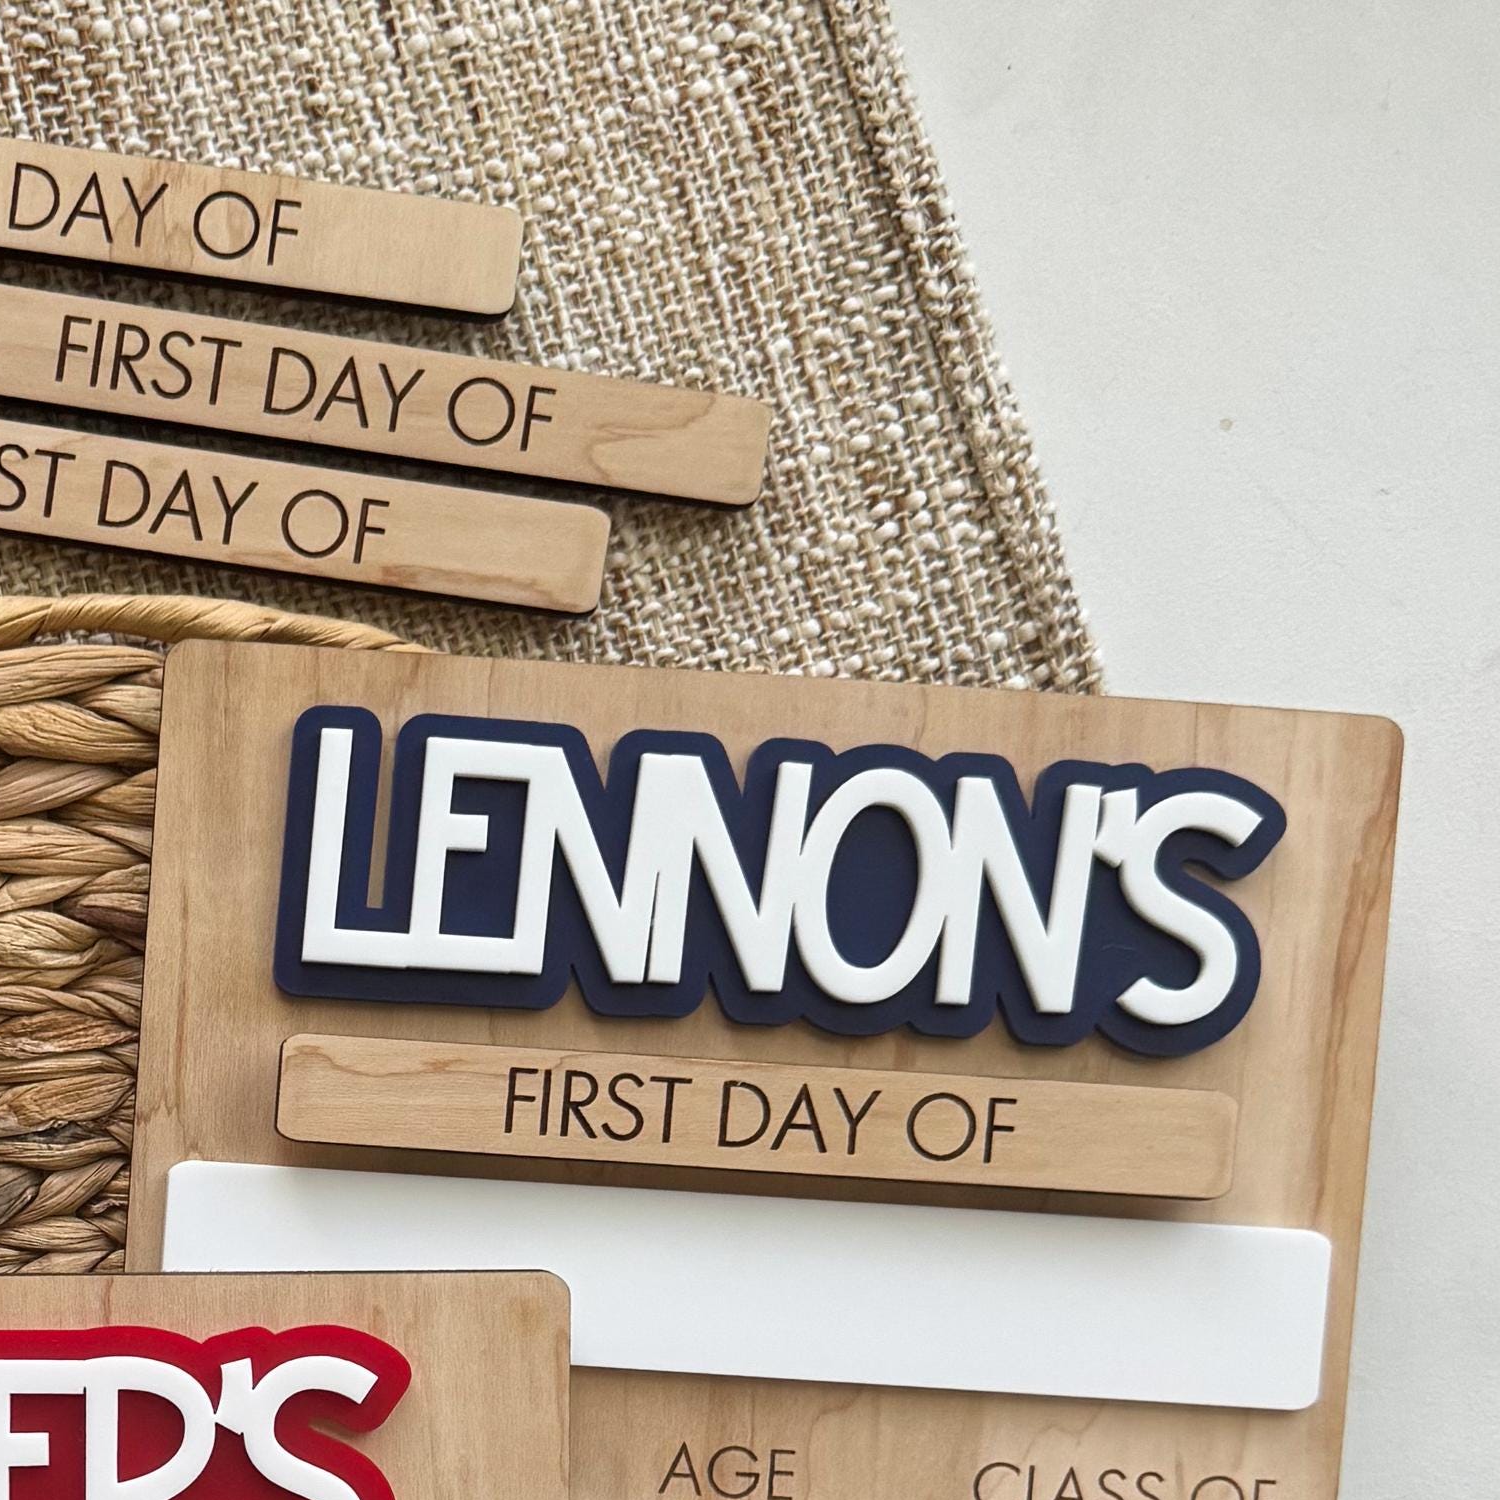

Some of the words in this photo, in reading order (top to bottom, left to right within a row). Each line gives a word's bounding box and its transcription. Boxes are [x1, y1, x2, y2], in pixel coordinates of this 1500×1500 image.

[7, 162, 169, 248] DAY
[193, 190, 302, 266] OF
[54, 315, 243, 407] FIRST
[262, 347, 426, 434] DAY
[447, 376, 557, 452] OF
[96, 460, 260, 547] DAY
[281, 489, 390, 564] OF
[300, 727, 1265, 1026] LENNON'S
[504, 1066, 693, 1144] FIRST
[717, 1079, 882, 1155] DAY
[906, 1092, 1018, 1164] OF
